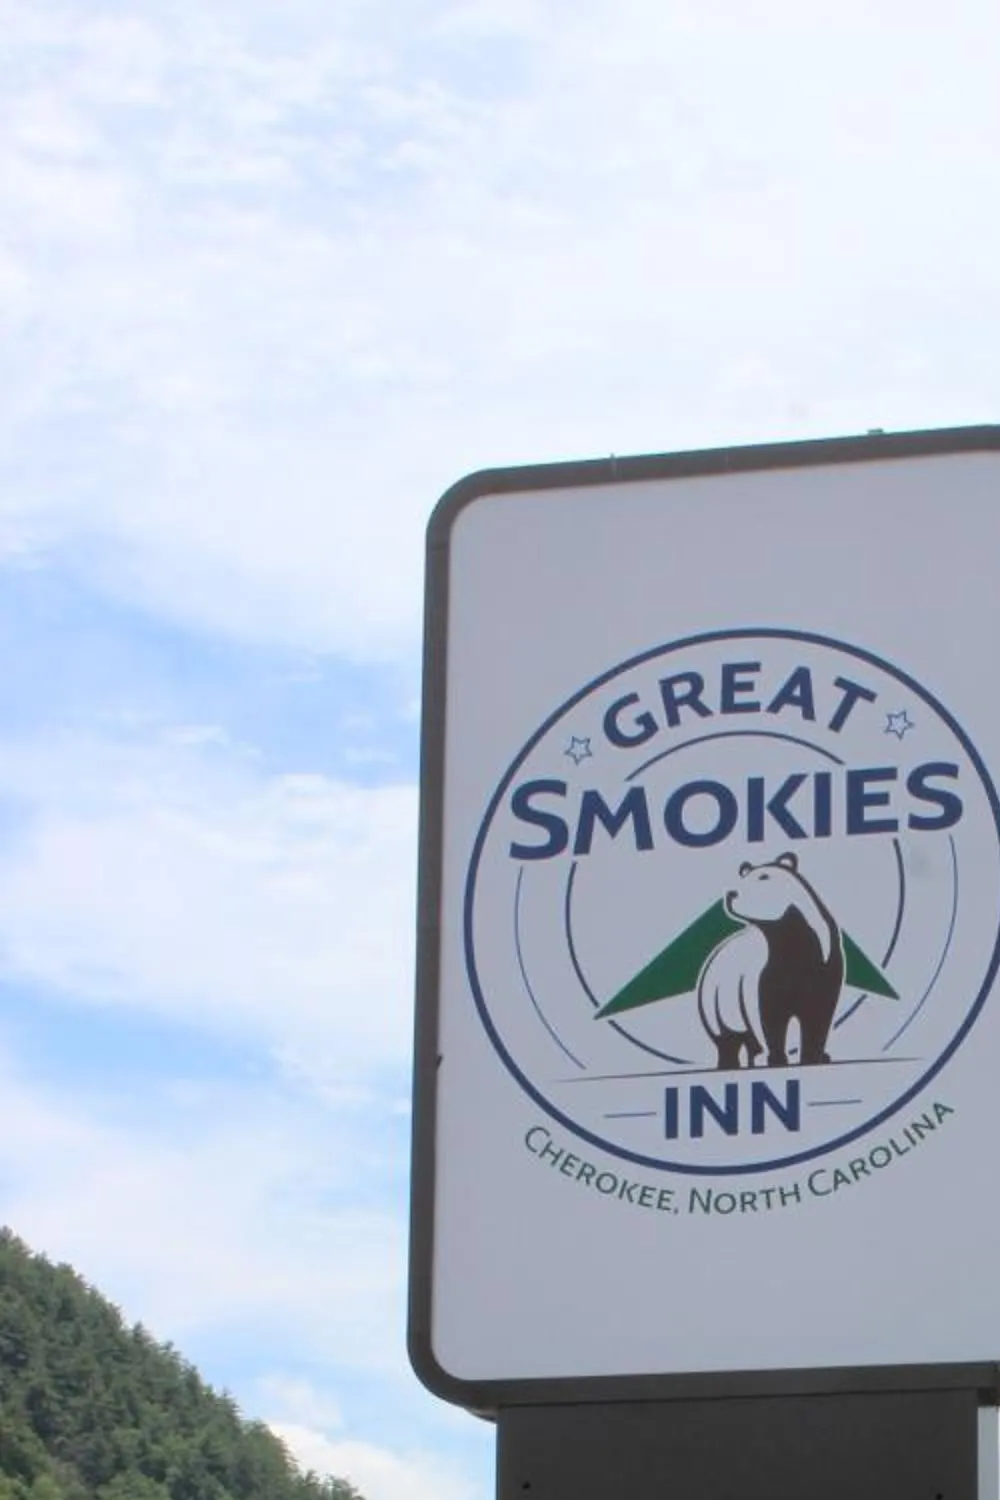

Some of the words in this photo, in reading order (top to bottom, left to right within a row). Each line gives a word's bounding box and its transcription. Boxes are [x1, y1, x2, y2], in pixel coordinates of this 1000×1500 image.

[602, 661, 876, 749] GREAT
[508, 762, 964, 861] SMOKIES
[664, 1079, 800, 1140] INN
[688, 1184, 801, 1215] NORTH
[807, 1101, 955, 1197] CAROLINA
